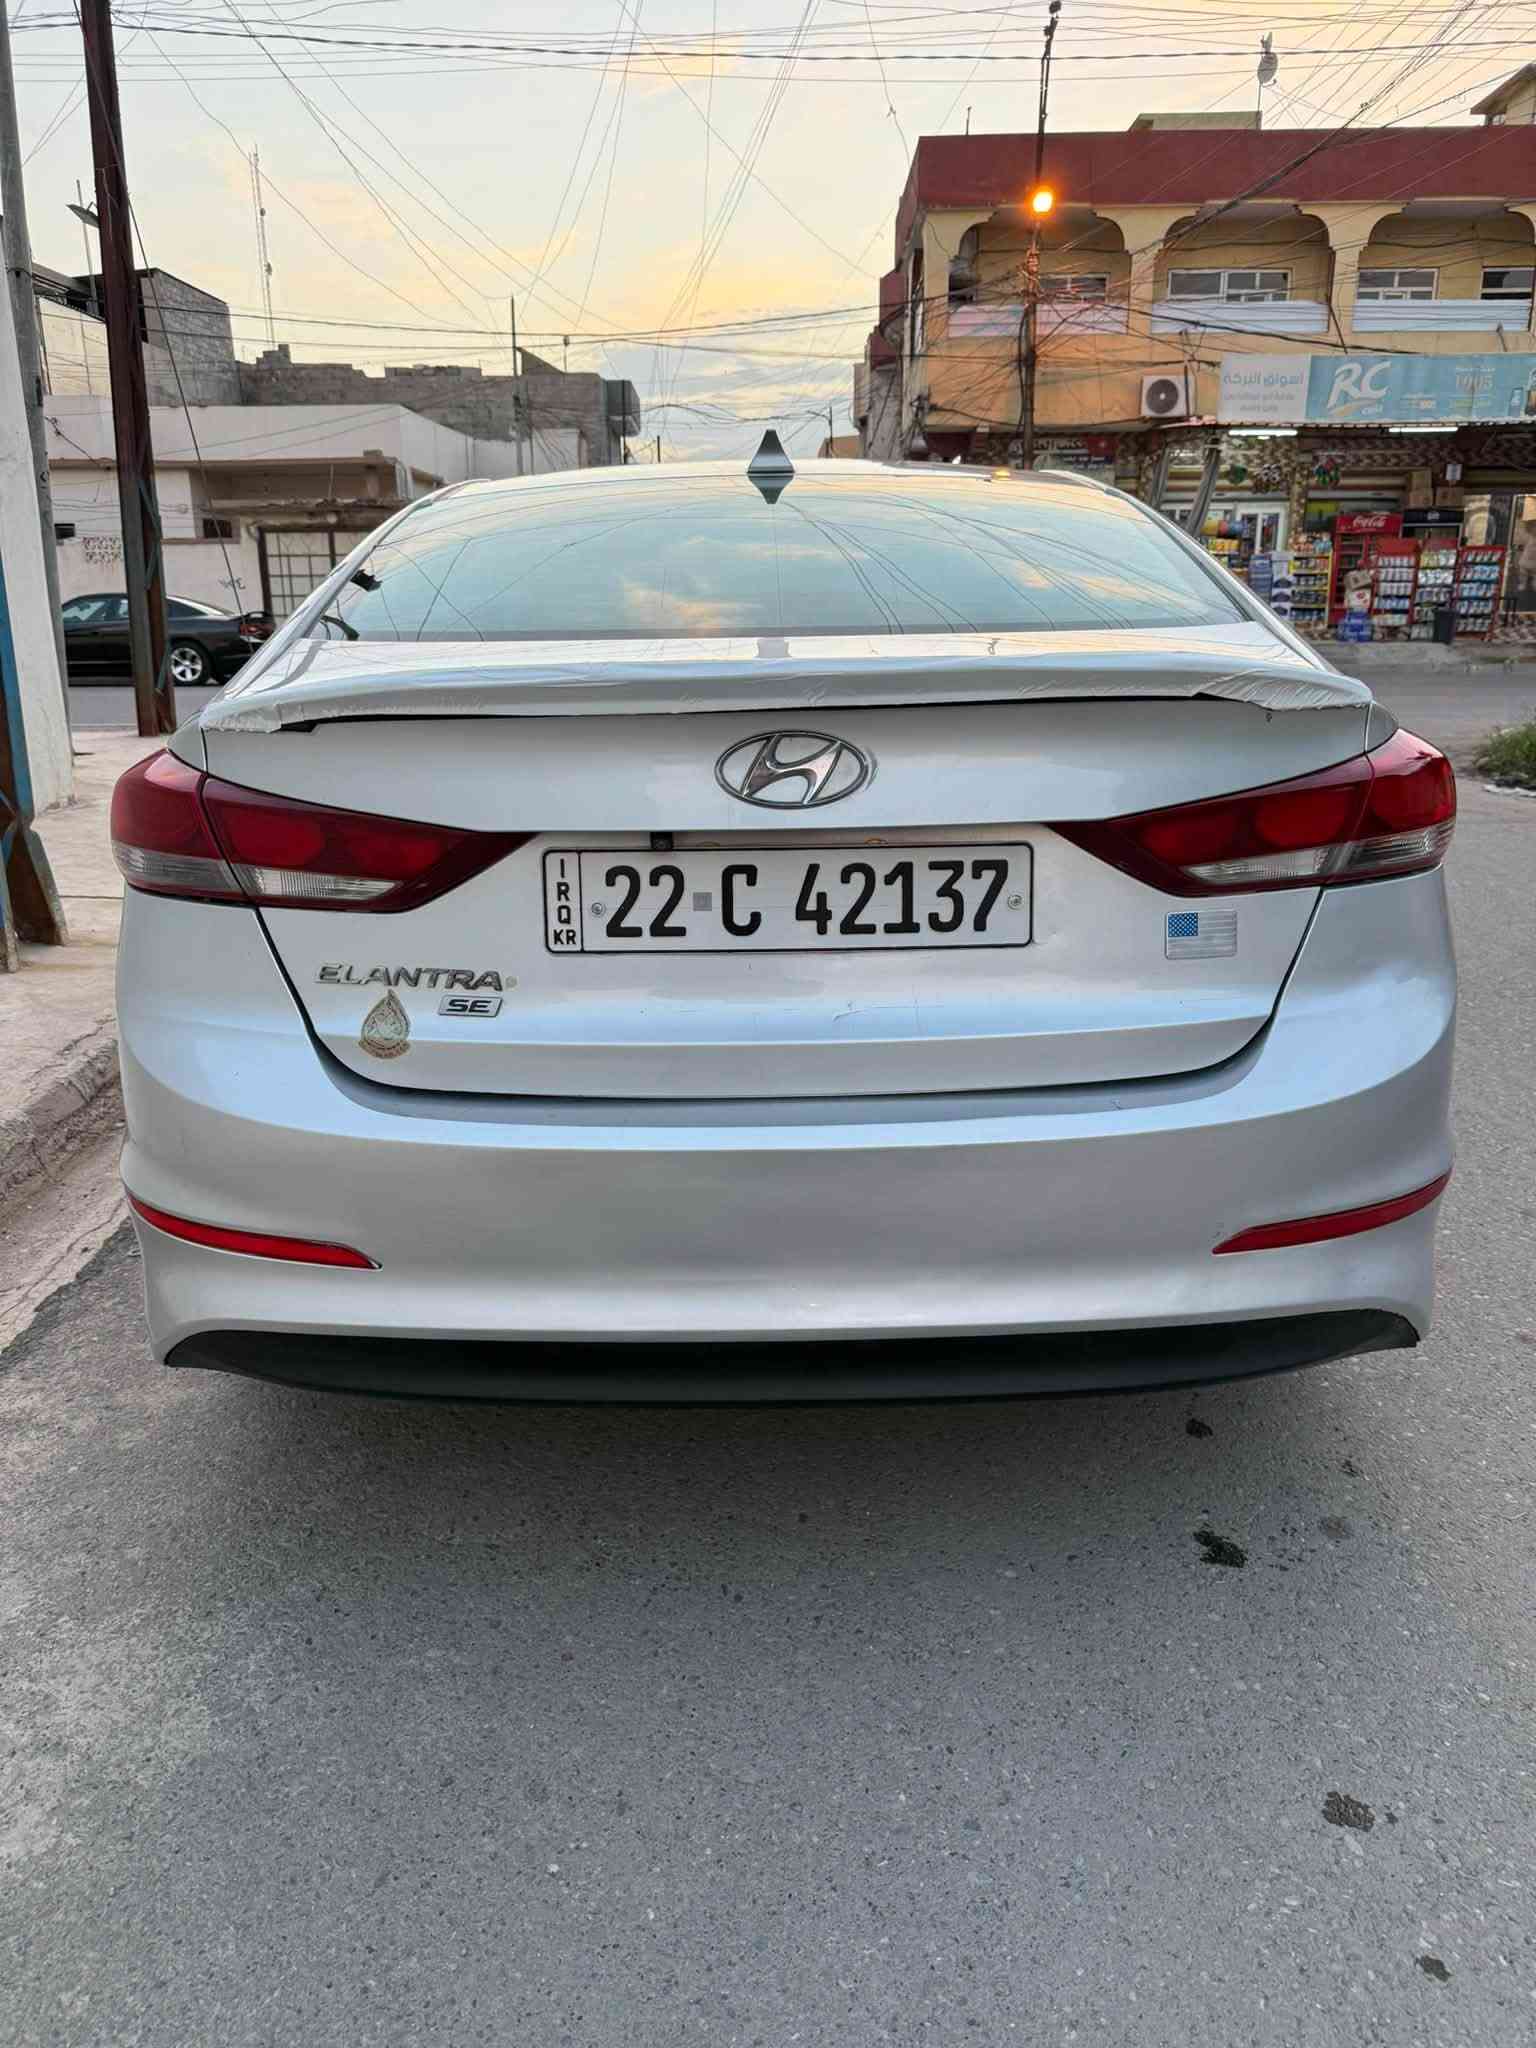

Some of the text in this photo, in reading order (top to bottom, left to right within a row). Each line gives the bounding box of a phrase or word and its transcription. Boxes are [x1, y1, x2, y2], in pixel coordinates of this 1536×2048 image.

[1327, 361, 1392, 409] RC
[605, 858, 1009, 938] 22 C 42137
[553, 929, 576, 946] KR
[317, 963, 504, 992] ELANTRA
[446, 999, 492, 1013] SE
